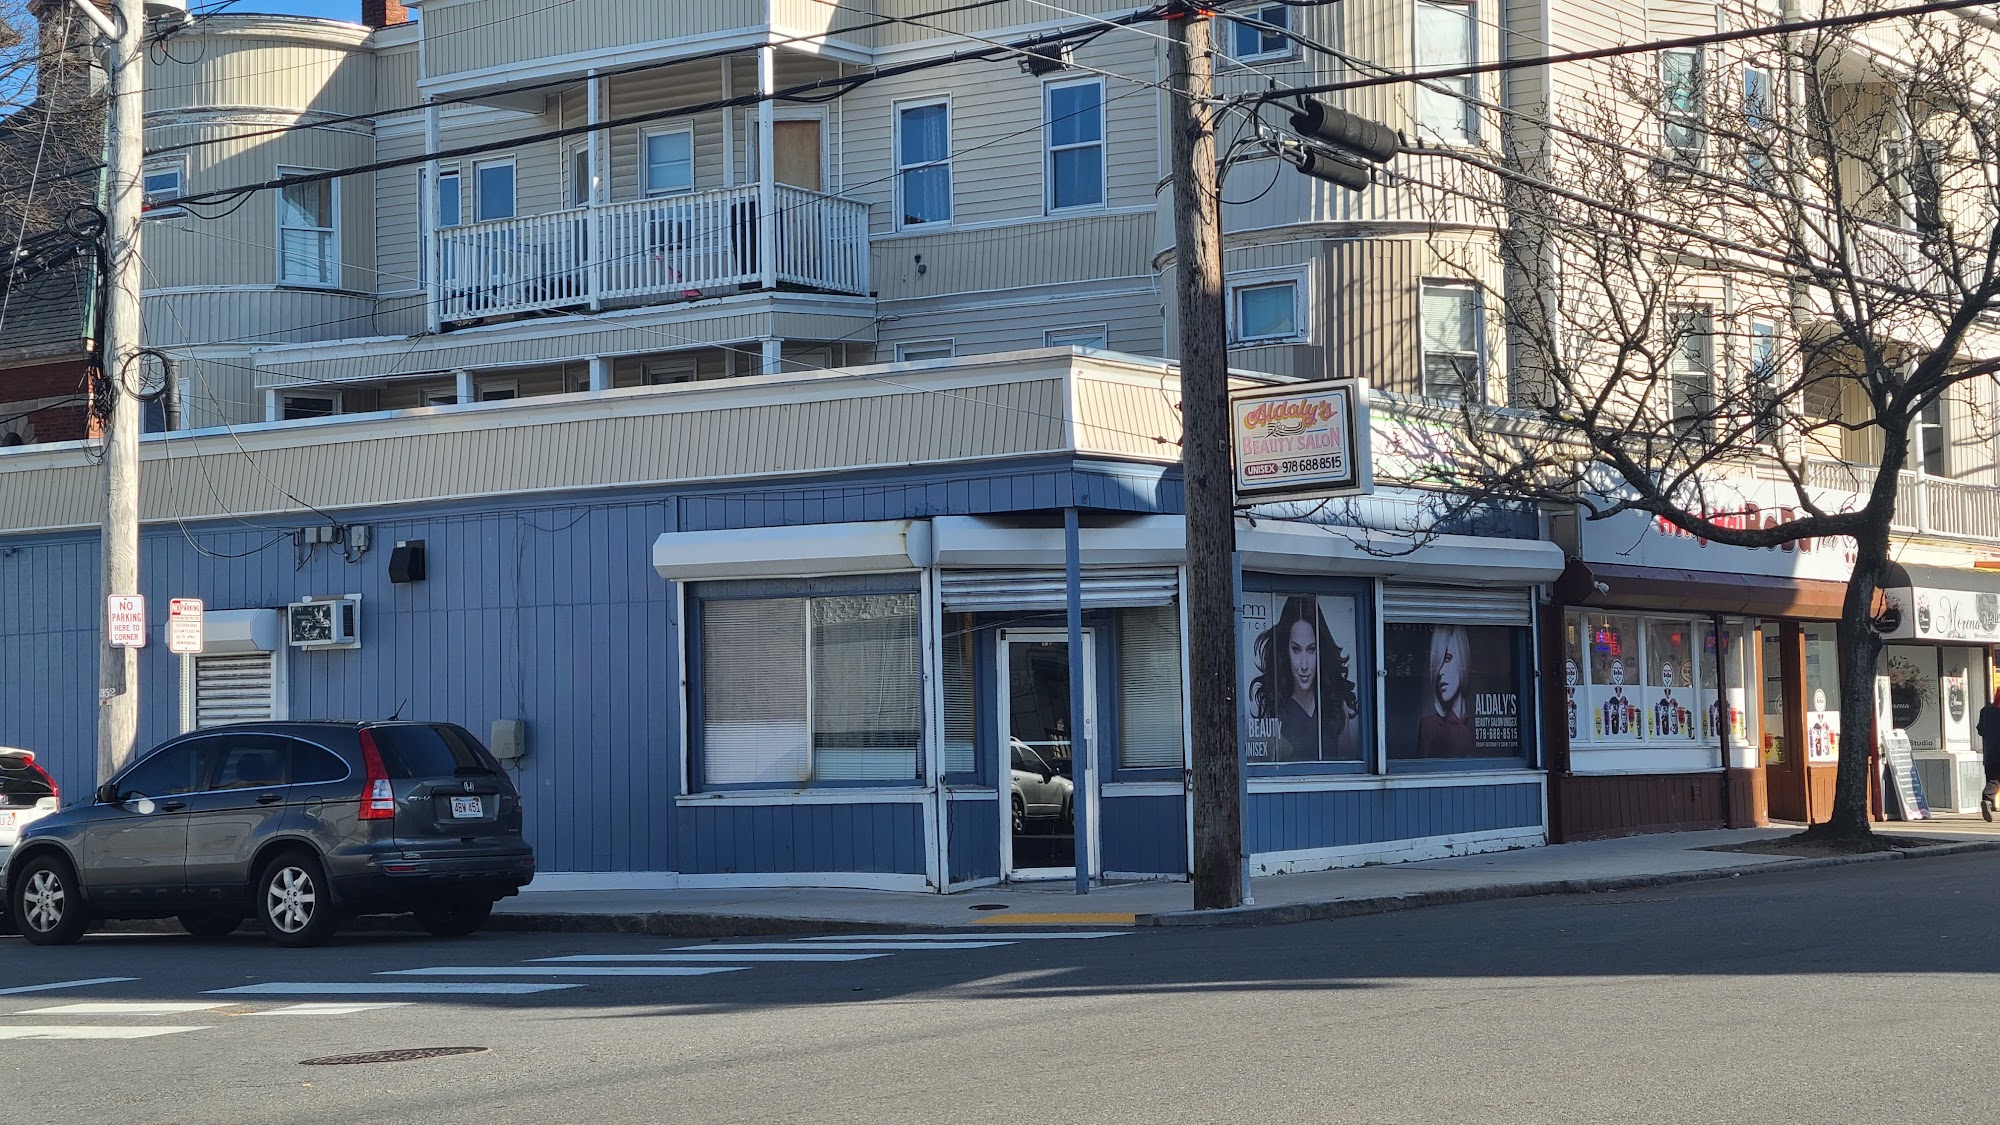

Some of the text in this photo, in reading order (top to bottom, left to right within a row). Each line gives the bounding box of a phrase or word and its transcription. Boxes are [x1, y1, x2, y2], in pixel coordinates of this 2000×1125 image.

[1244, 398, 1338, 429] Aldaly's
[1243, 427, 1340, 456] BEAUTY SALON
[1247, 463, 1276, 475] UNISEX
[119, 602, 133, 611] NO
[172, 602, 200, 614] NO PARKING
[1242, 603, 1266, 616] rm
[111, 612, 142, 622] PARKING
[114, 624, 140, 632] HERE TO
[114, 633, 139, 641] CORNER
[1475, 693, 1517, 715] ALDALY'S
[1248, 717, 1282, 739] BEAUTY
[1475, 717, 1490, 727] BEAUTY
[468, 802, 481, 813] 451
